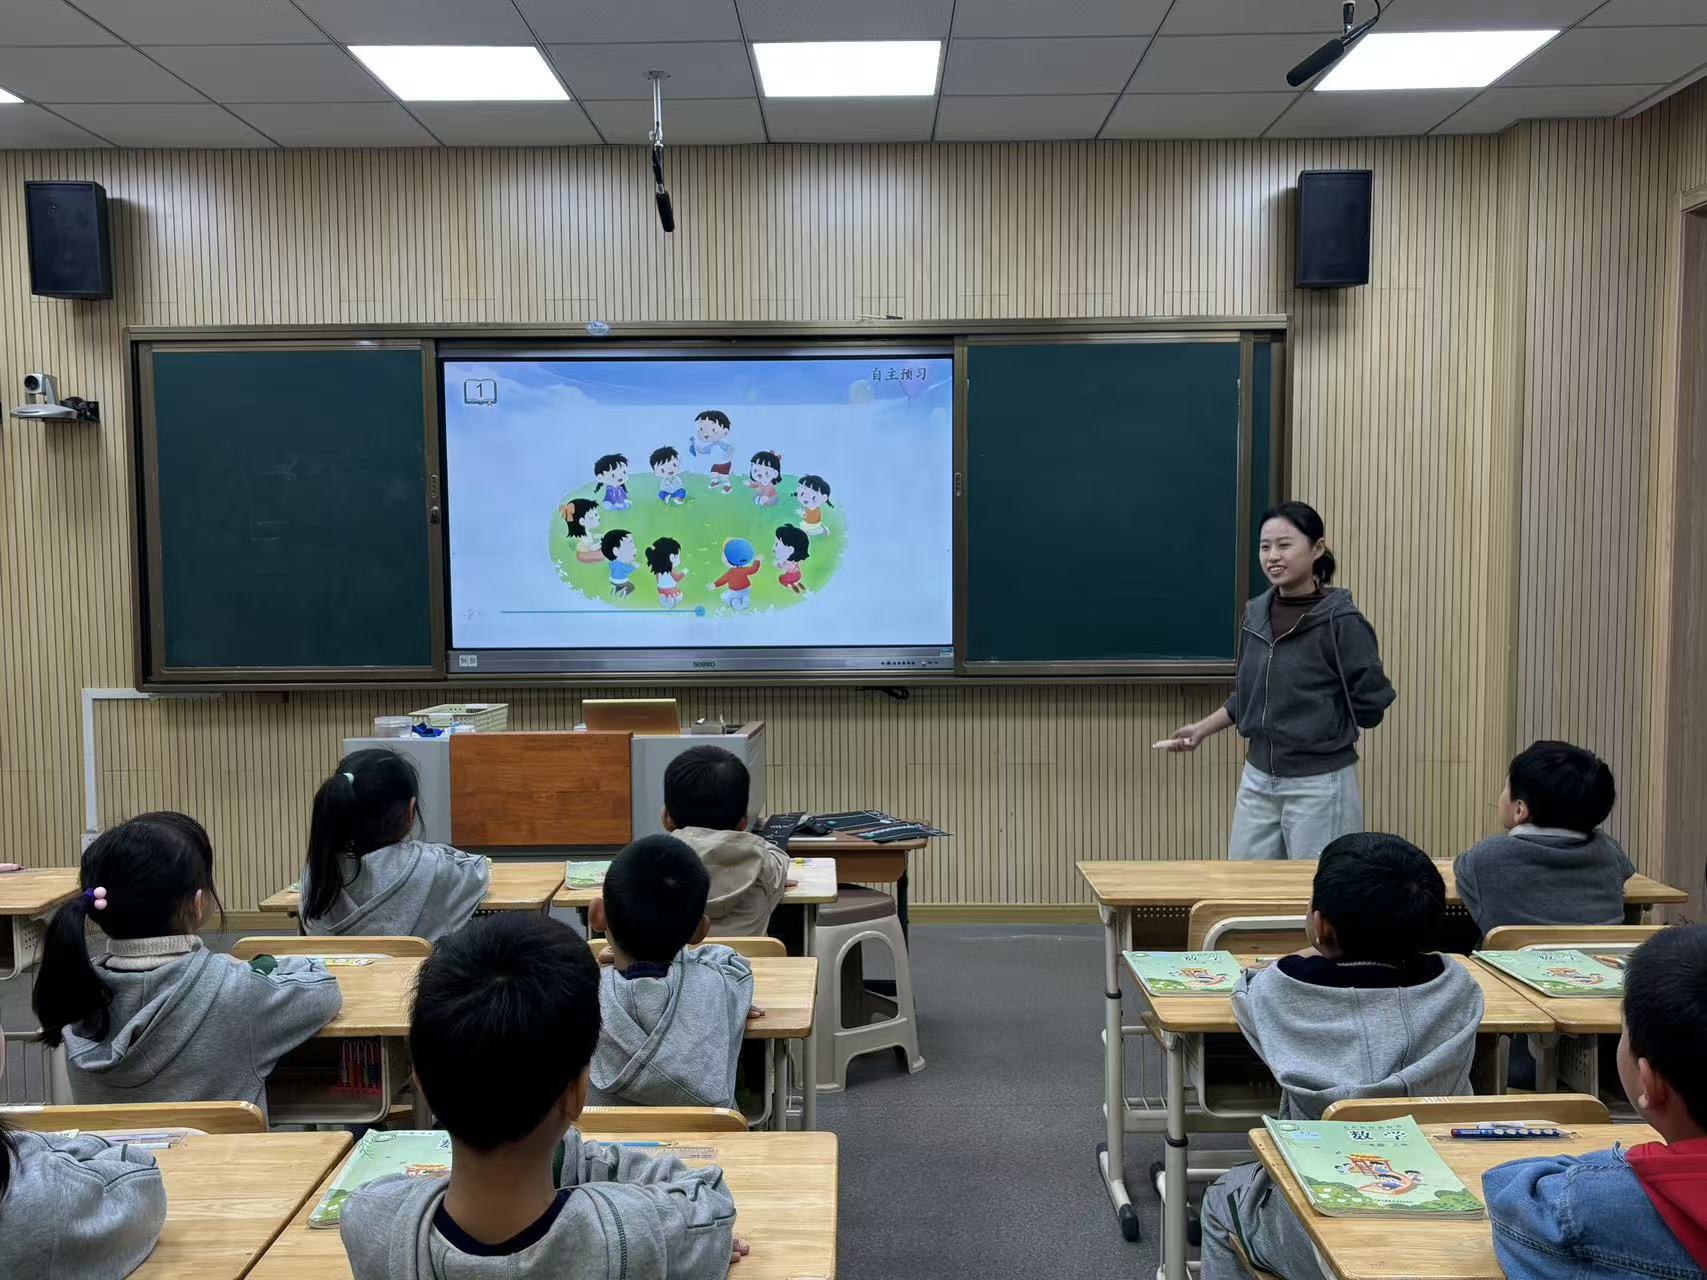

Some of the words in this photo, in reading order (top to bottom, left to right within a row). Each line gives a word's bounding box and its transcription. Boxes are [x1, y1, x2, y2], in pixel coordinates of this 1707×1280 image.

[872, 367, 927, 381] 自主预习
[476, 383, 482, 398] 1
[1349, 1130, 1408, 1141] 数学
